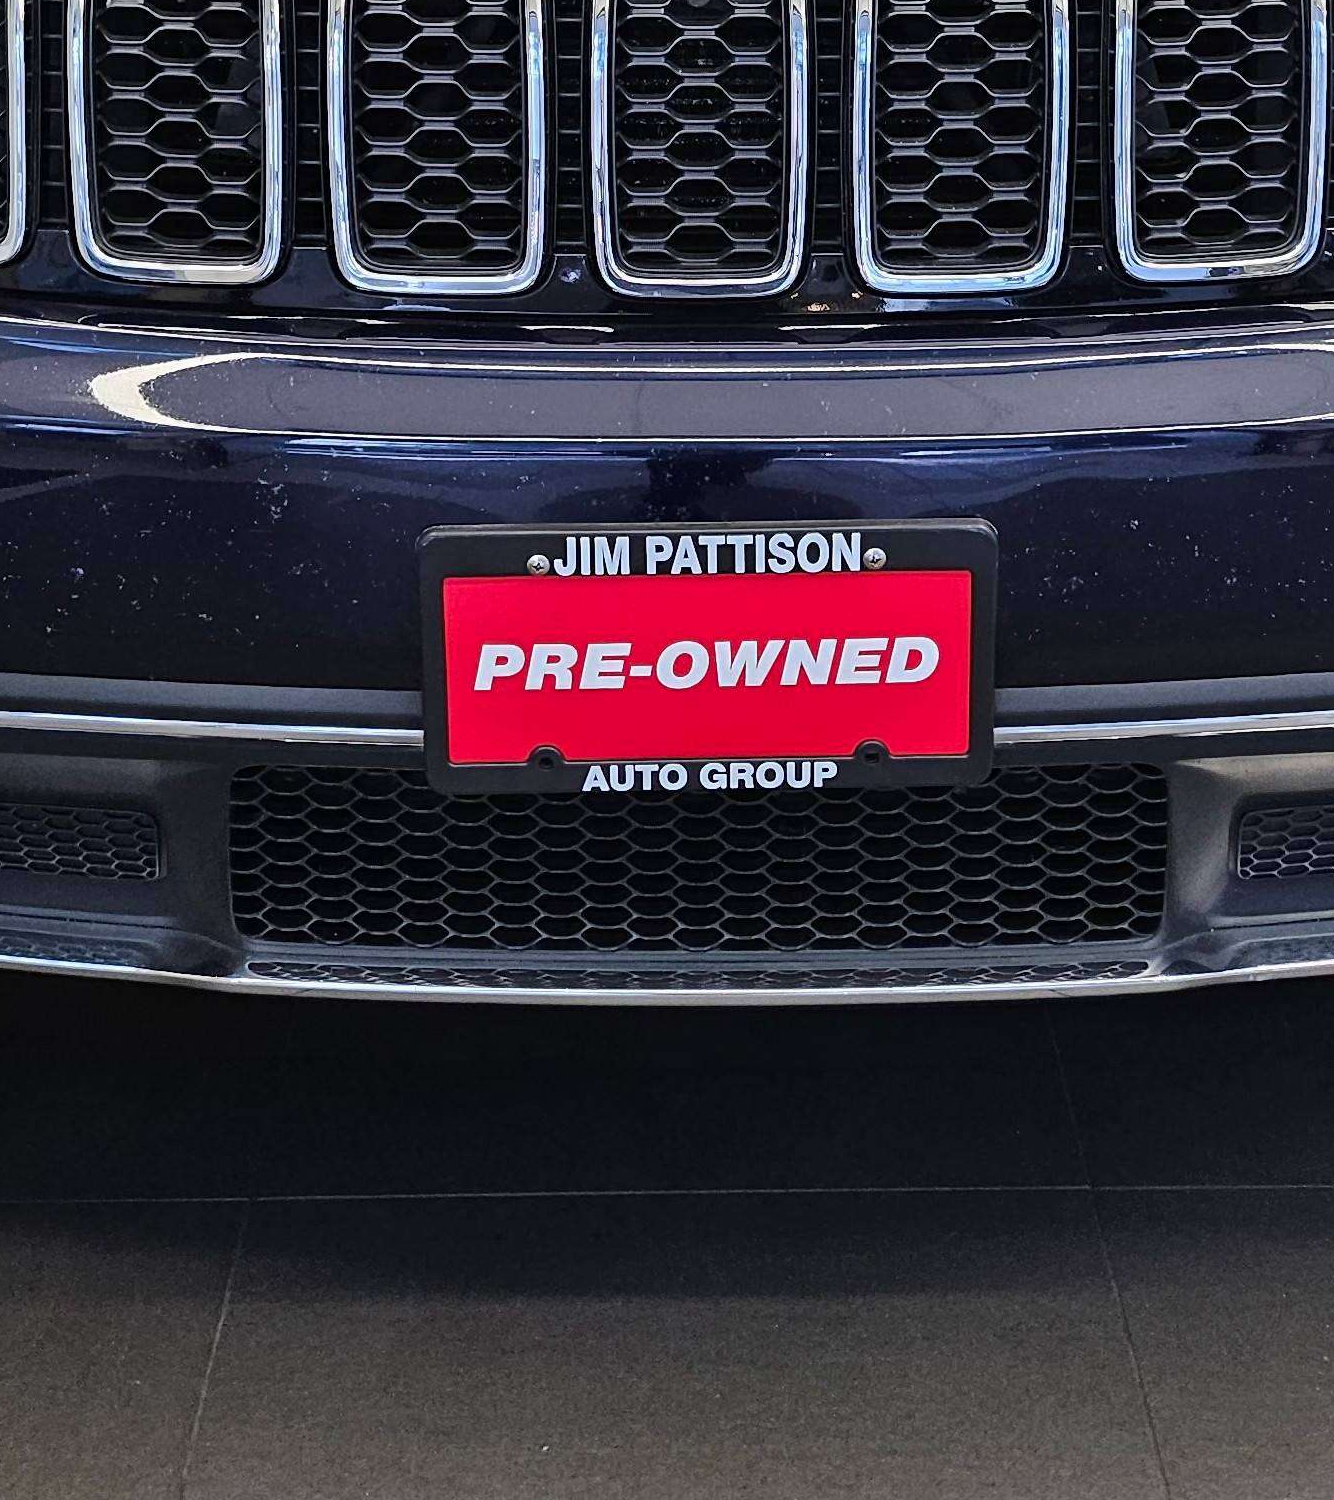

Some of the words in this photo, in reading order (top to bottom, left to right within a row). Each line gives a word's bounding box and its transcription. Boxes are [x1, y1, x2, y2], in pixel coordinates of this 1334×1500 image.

[553, 536, 630, 576] JIM
[645, 532, 862, 575] PATTISON
[473, 636, 941, 691] PRE-OWNED
[581, 763, 688, 792] AUTO
[699, 761, 838, 790] GROUP
